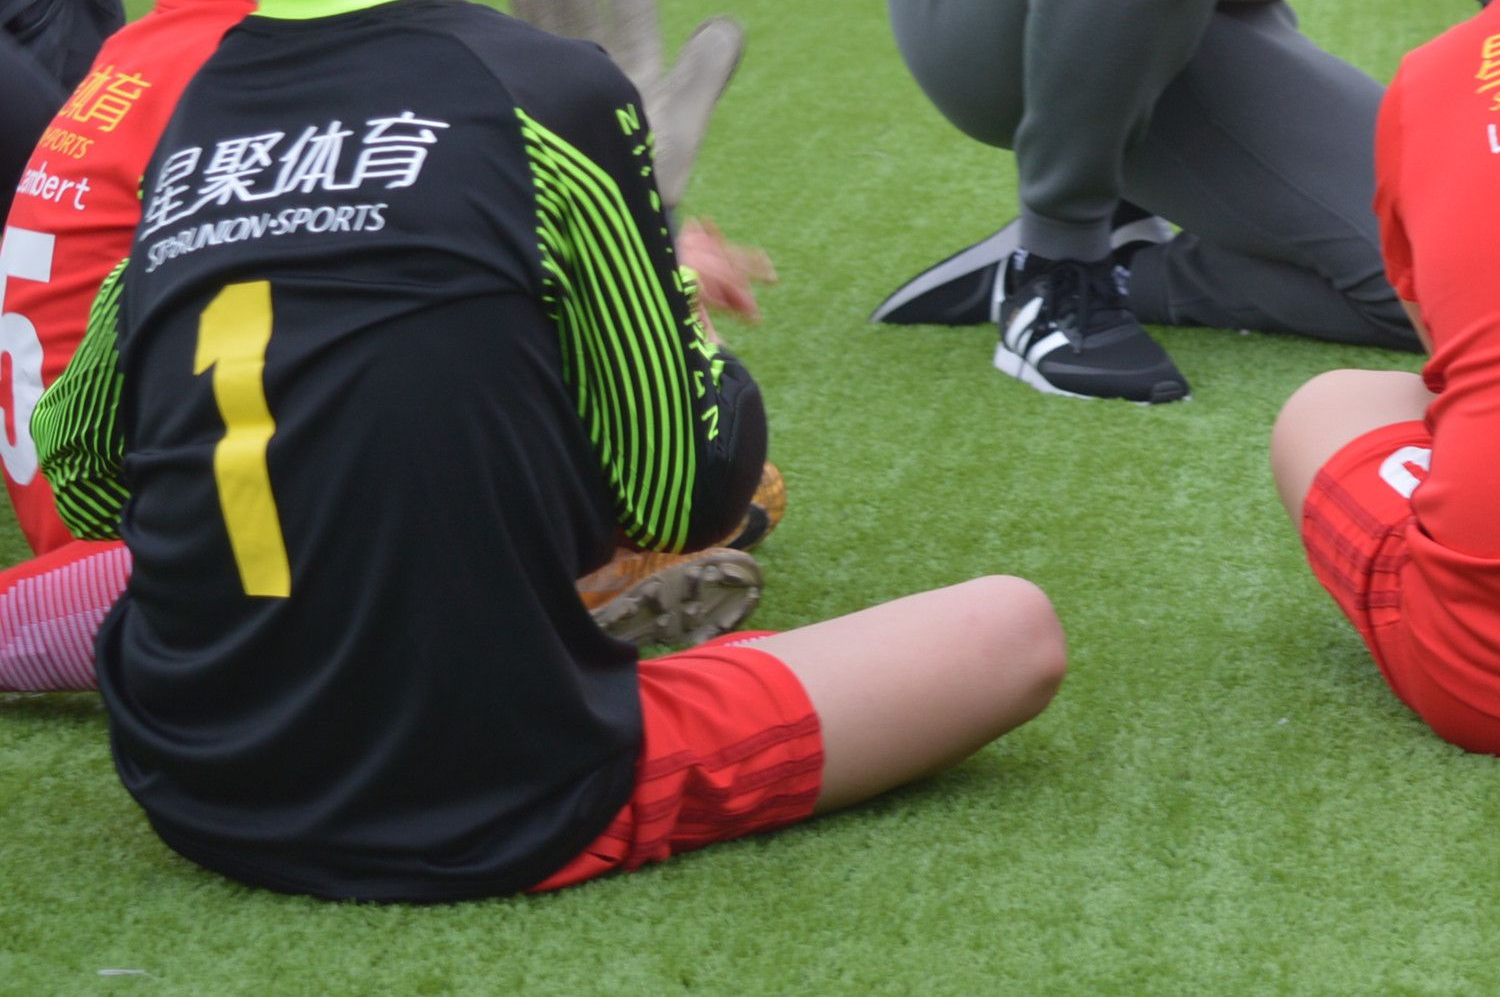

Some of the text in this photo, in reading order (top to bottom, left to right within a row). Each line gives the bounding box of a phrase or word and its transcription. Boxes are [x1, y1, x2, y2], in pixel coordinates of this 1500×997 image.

[139, 111, 450, 241] 星聚体育
[193, 279, 292, 598] 1
